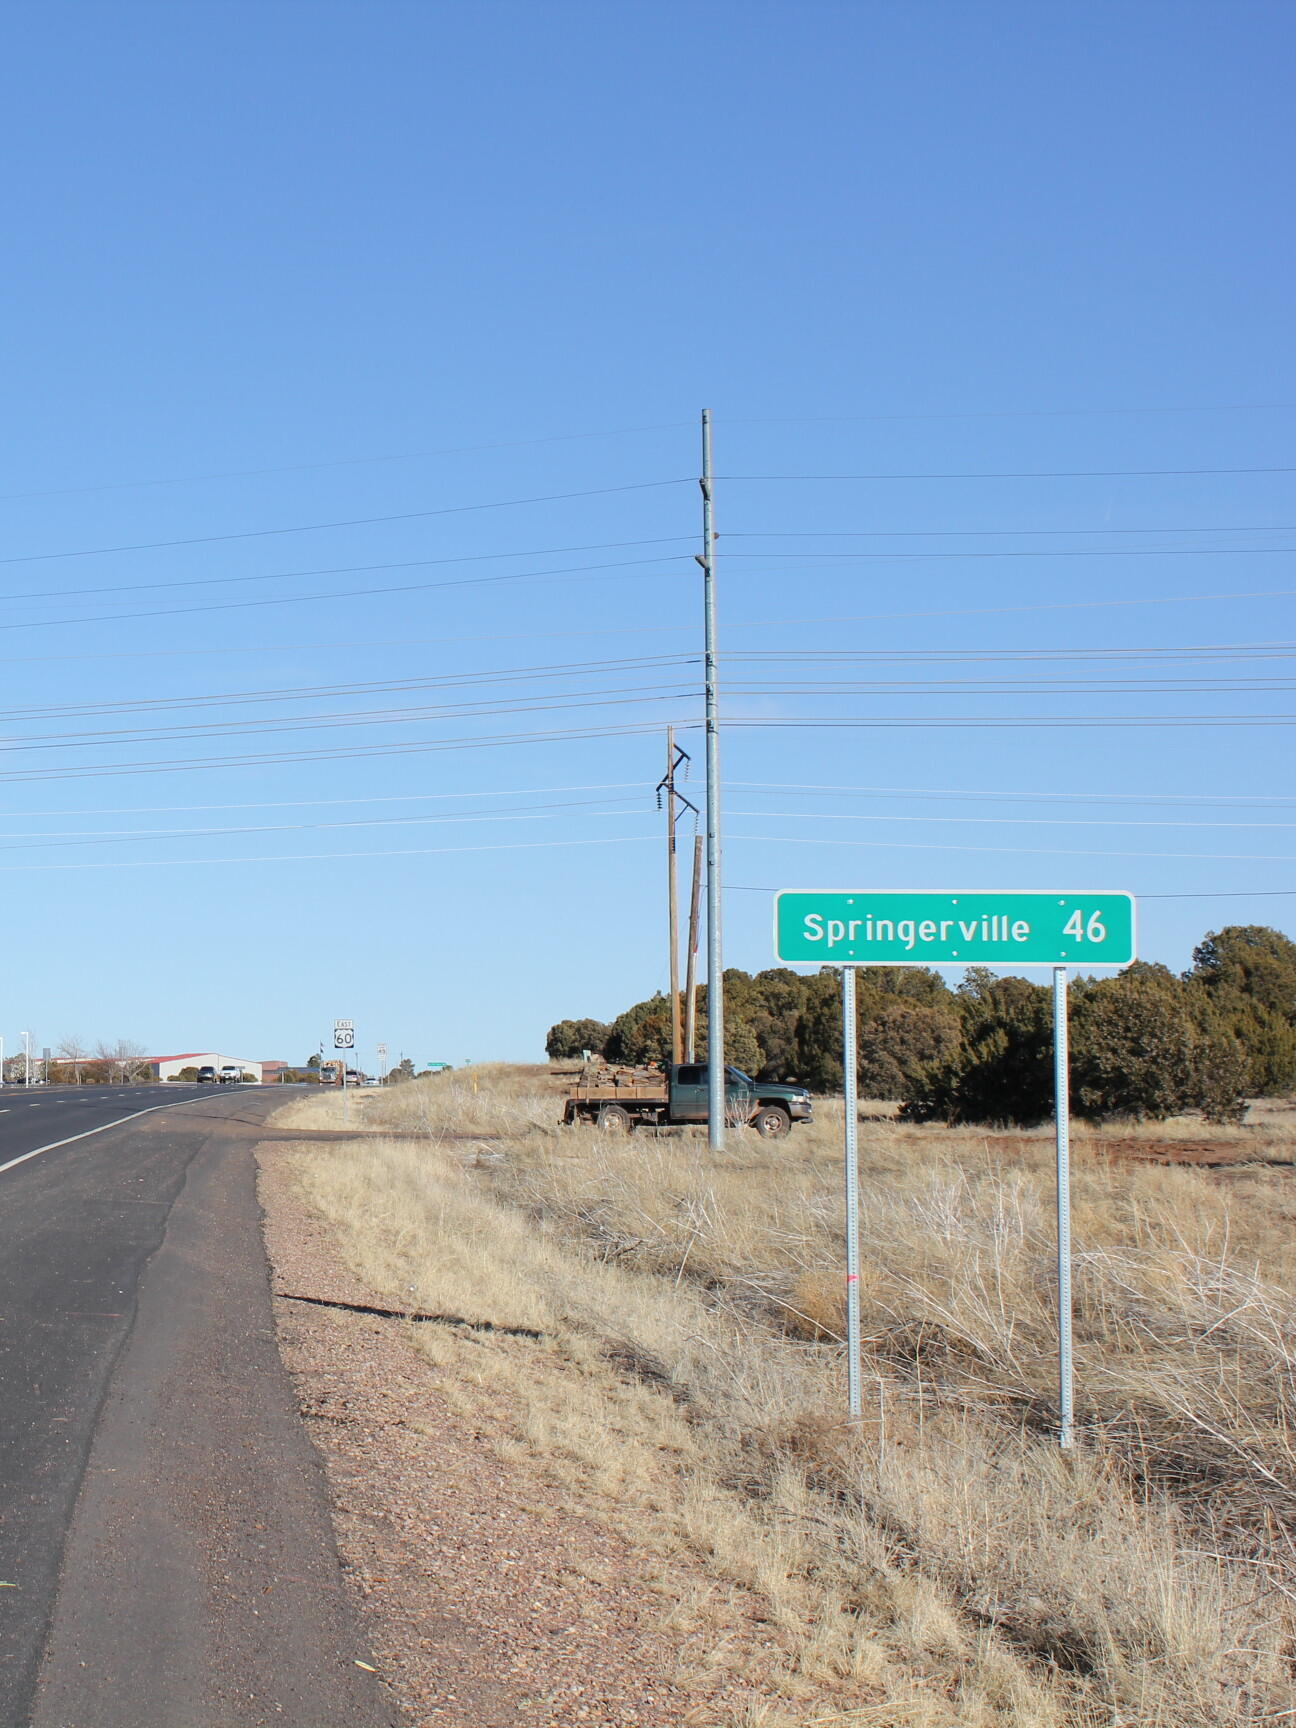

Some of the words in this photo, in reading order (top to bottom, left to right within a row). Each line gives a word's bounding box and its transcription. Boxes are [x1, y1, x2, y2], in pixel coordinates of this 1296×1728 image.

[803, 913, 1031, 950] Springerville
[1062, 909, 1107, 943] 46
[336, 1033, 352, 1045] 60
